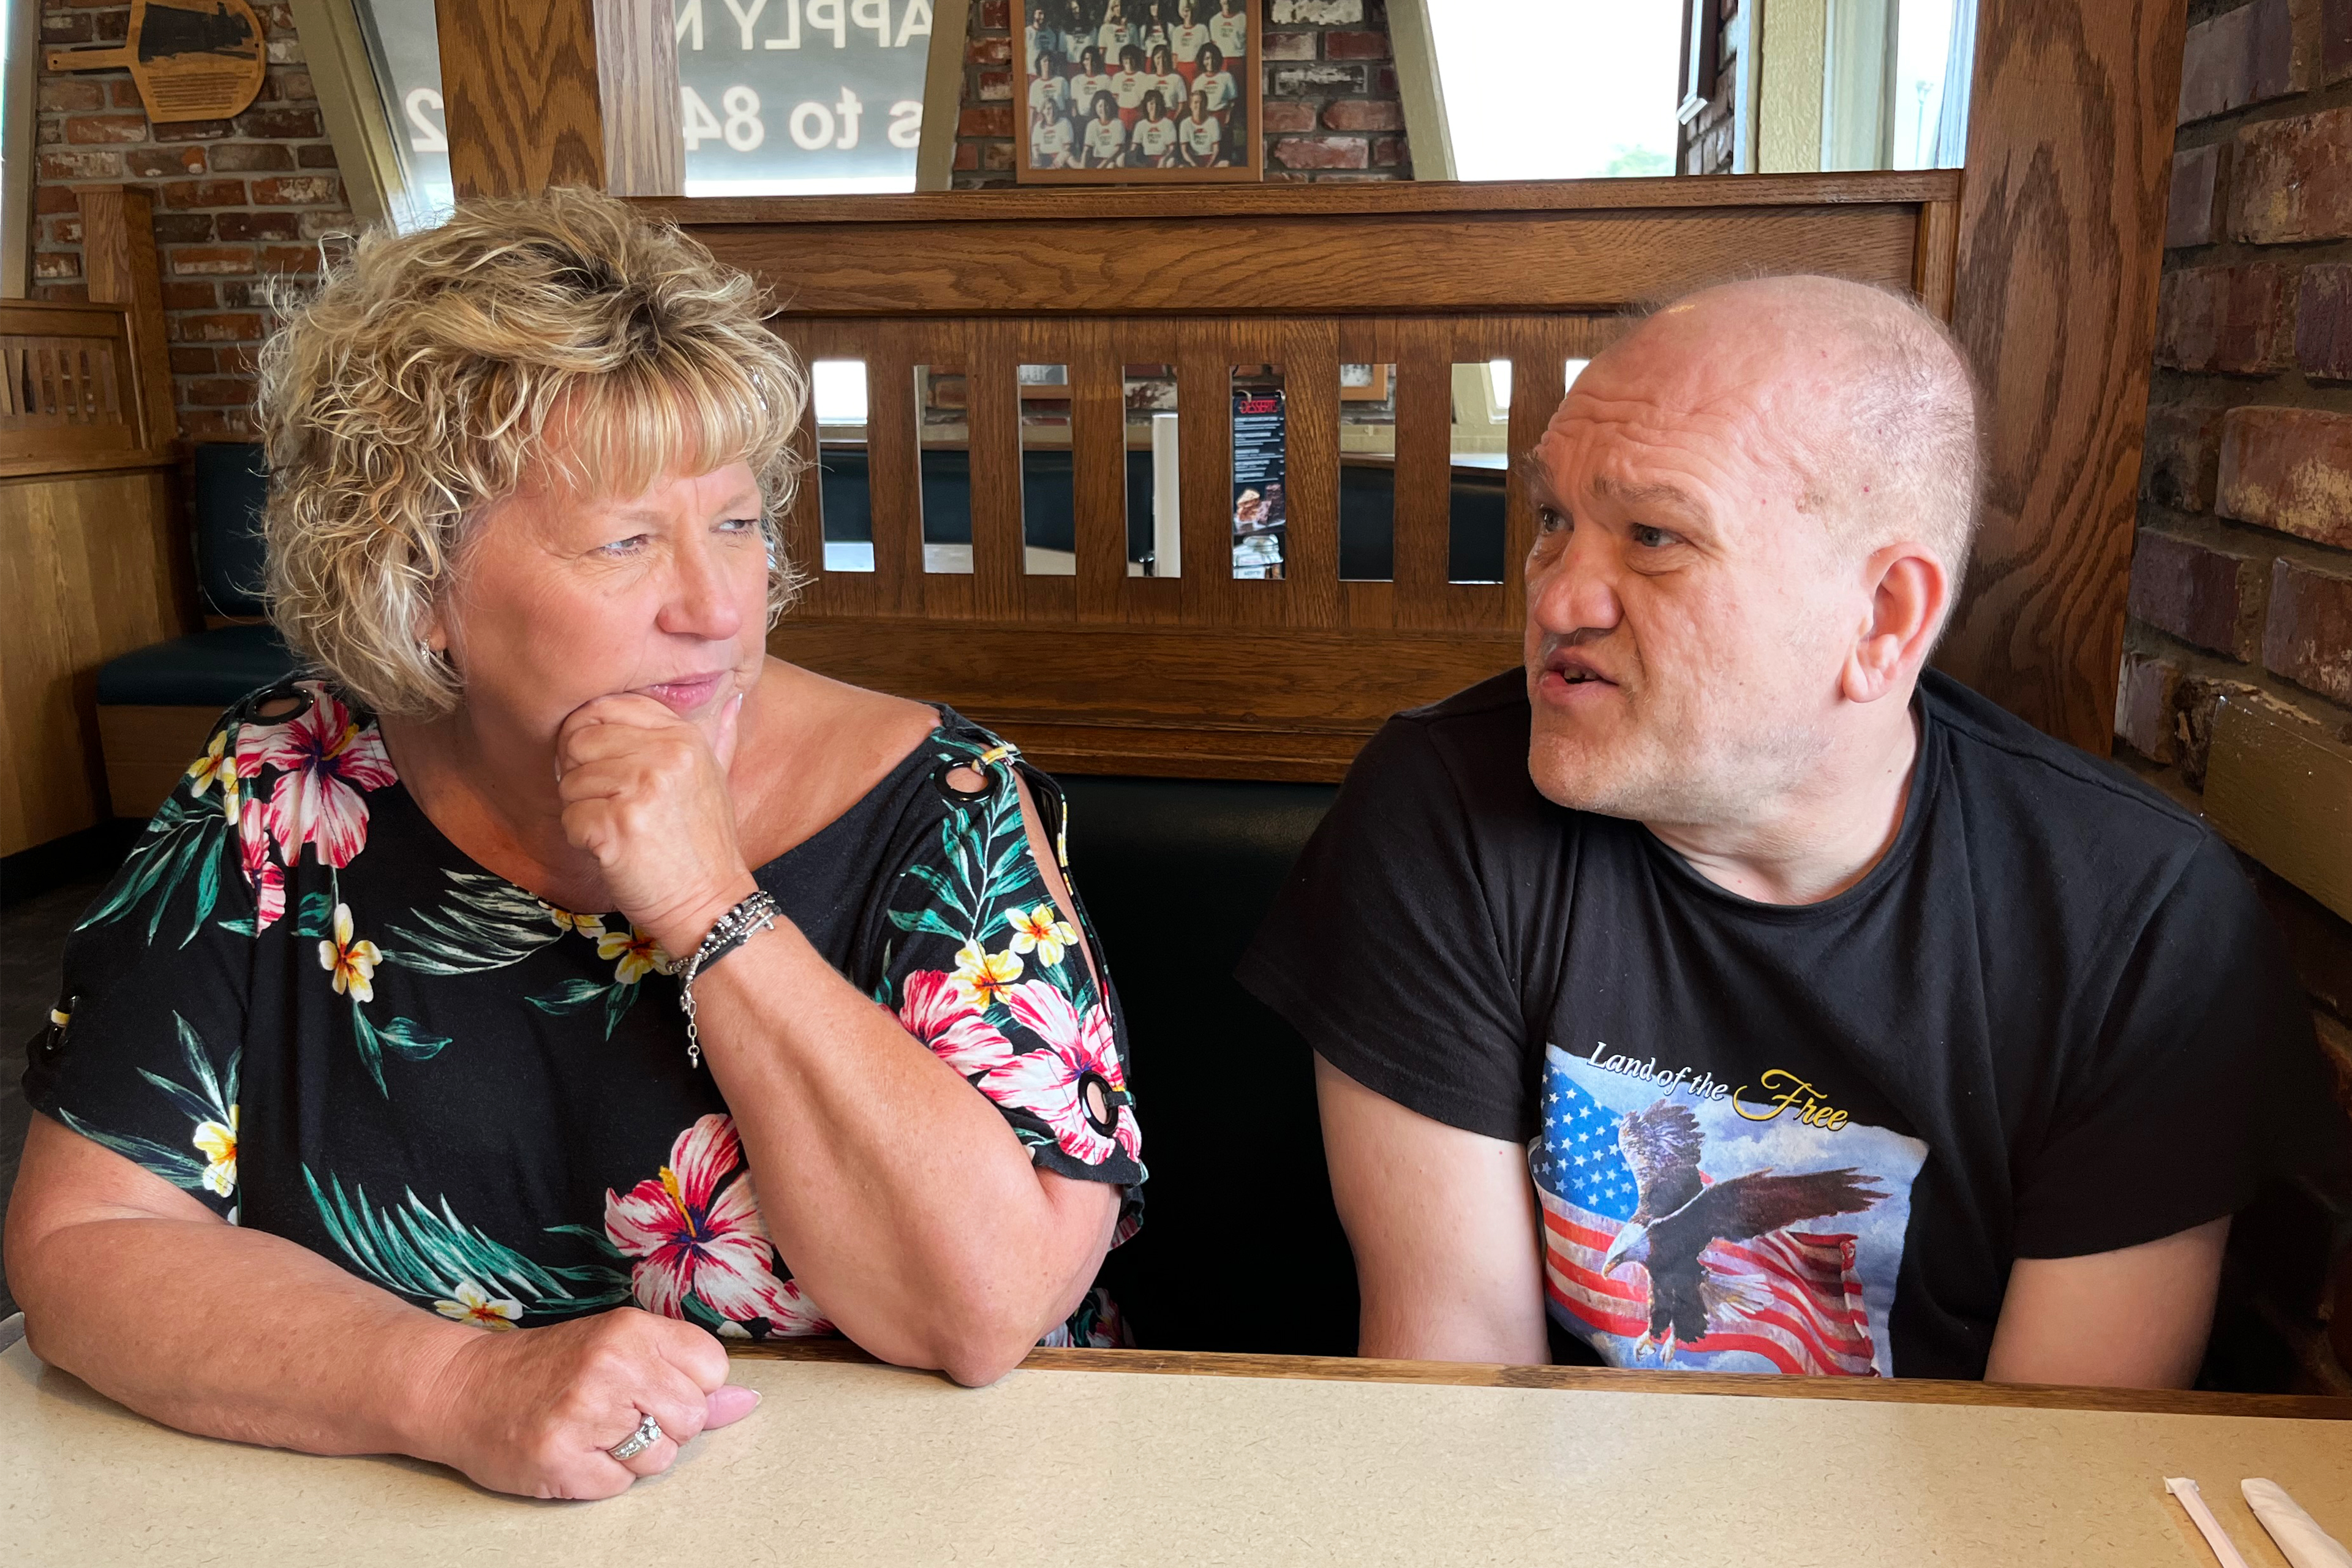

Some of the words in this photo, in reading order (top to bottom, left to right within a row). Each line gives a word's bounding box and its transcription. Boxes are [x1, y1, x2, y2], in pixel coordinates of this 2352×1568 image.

[1587, 1041, 1656, 1082] Land
[1656, 1066, 1692, 1096] of
[1689, 1072, 1728, 1101] the
[1733, 1069, 1848, 1131] Free
